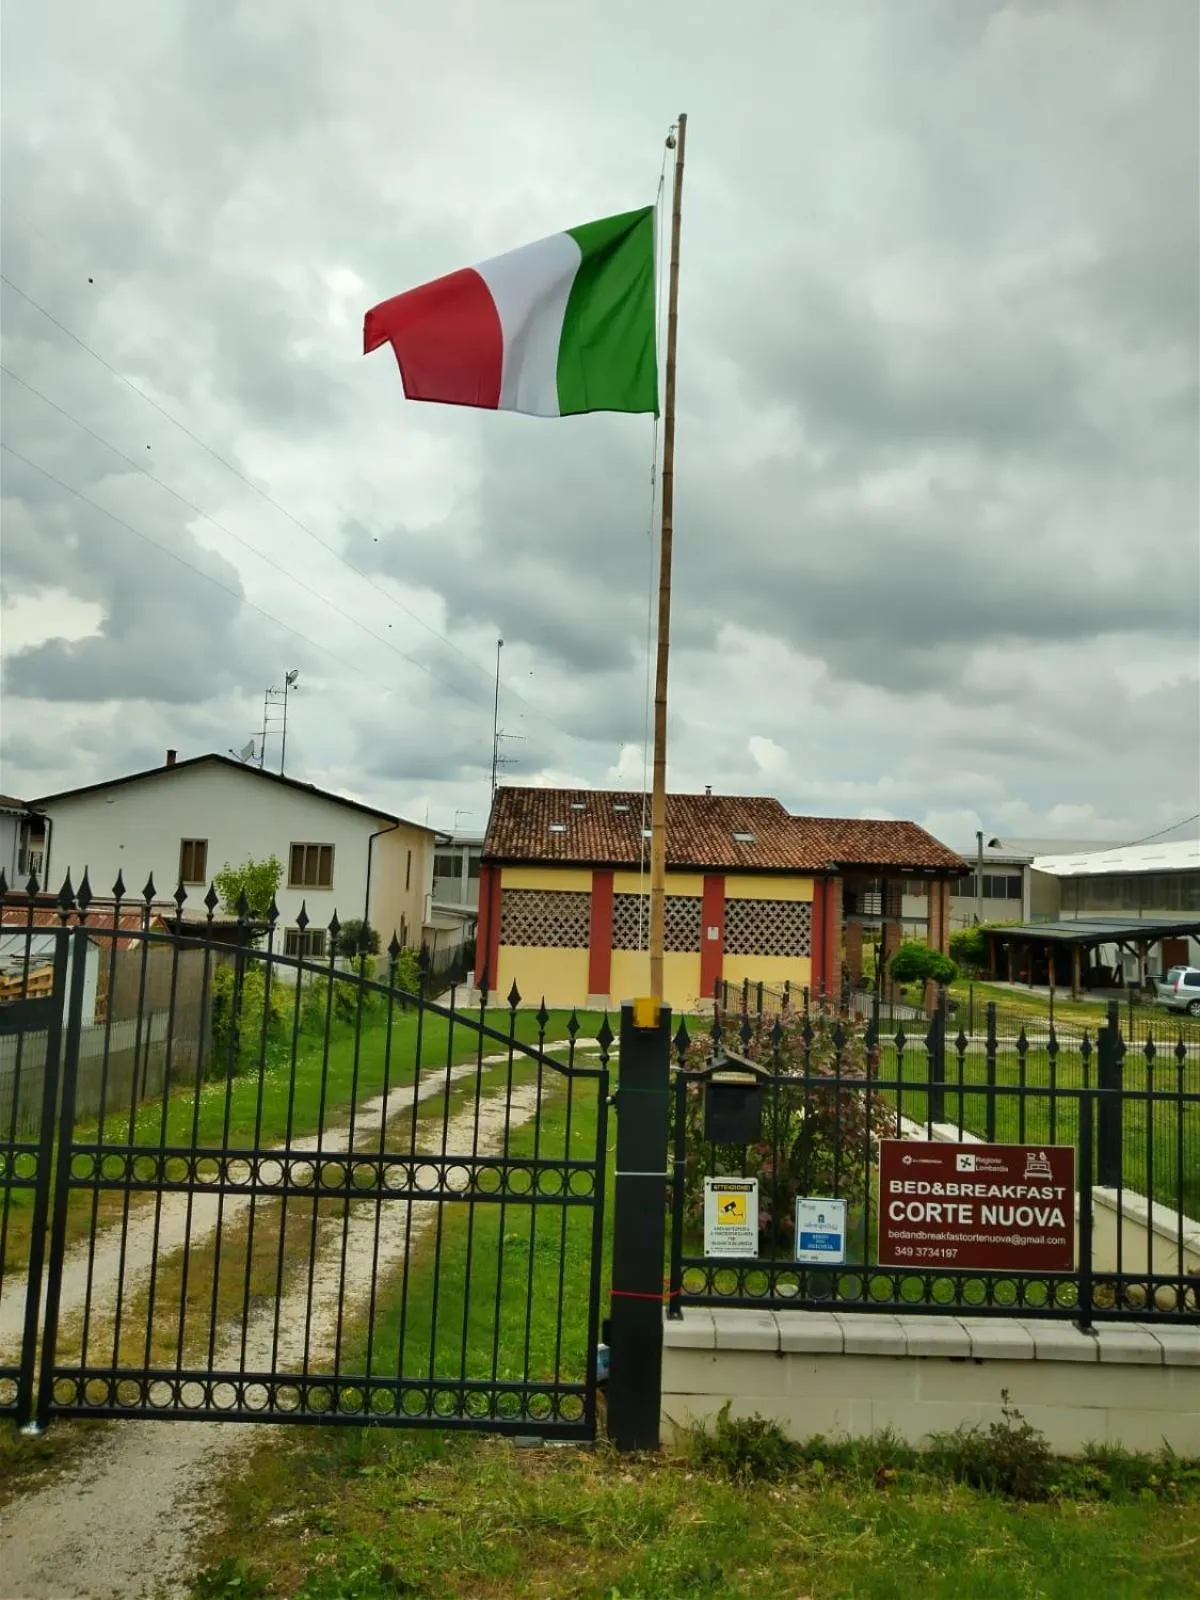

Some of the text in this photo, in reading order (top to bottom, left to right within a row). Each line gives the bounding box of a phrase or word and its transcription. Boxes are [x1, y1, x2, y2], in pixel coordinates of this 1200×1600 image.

[889, 1180, 1067, 1200] BED&BREAKFAST
[888, 1201, 1066, 1228] CORTE NUOVA
[888, 1230, 1066, 1245] bedandbreakfastcortenuova@gmail.com
[894, 1246, 958, 1259] 349 3734197
